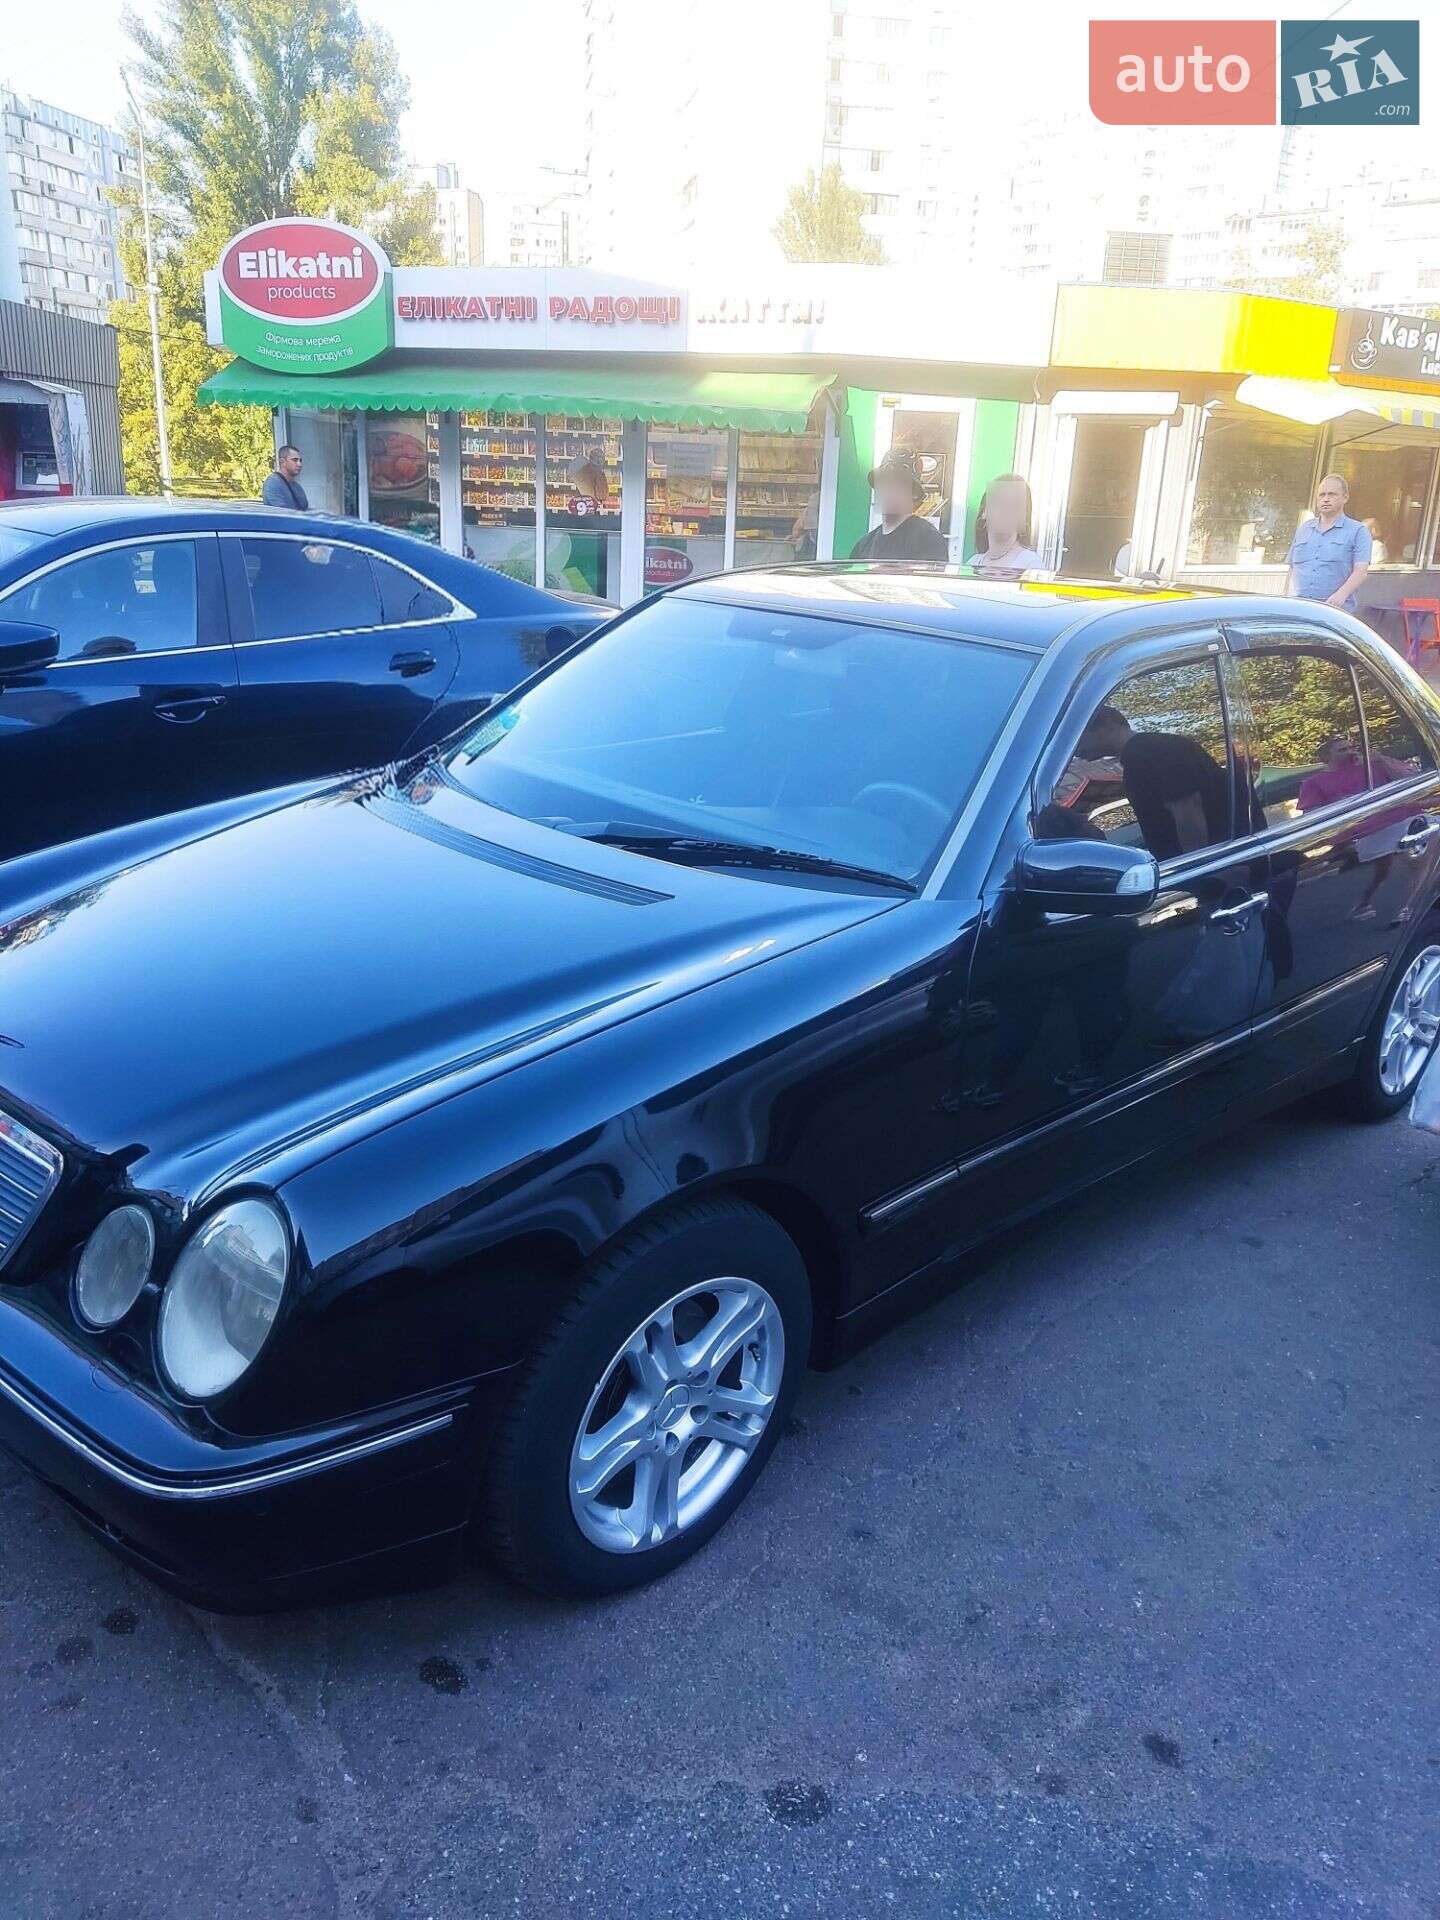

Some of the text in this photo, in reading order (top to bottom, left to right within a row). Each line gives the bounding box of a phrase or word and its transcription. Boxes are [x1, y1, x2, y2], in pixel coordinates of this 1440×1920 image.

[238, 246, 363, 279] Elikatni
[267, 284, 337, 301] products
[397, 295, 536, 320] ЕЛІКАТНІ
[548, 295, 681, 324] РАДОЩІ
[305, 334, 342, 347] мережа
